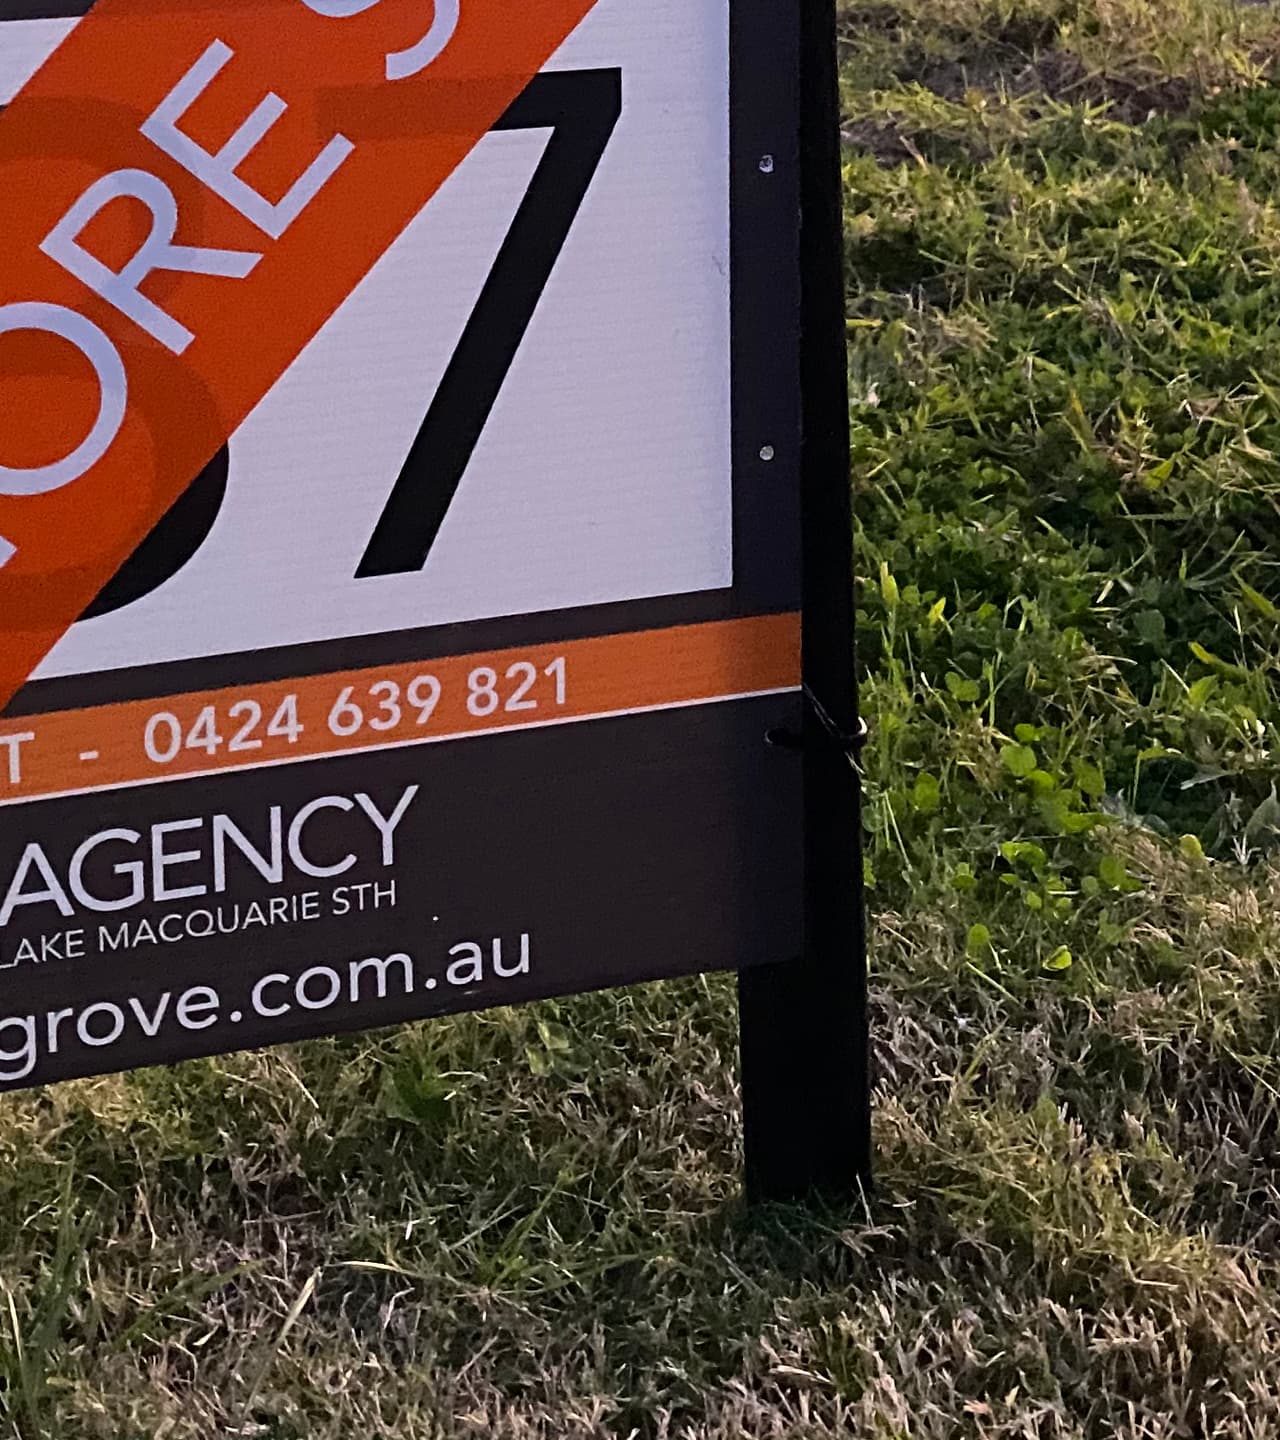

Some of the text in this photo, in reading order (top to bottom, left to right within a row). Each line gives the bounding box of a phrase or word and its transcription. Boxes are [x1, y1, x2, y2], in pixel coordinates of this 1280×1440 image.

[143, 693, 304, 763] 0424
[326, 674, 441, 738] 639
[465, 656, 568, 717] 821
[97, 891, 321, 953] MACQUARIE
[331, 879, 398, 916] STH
